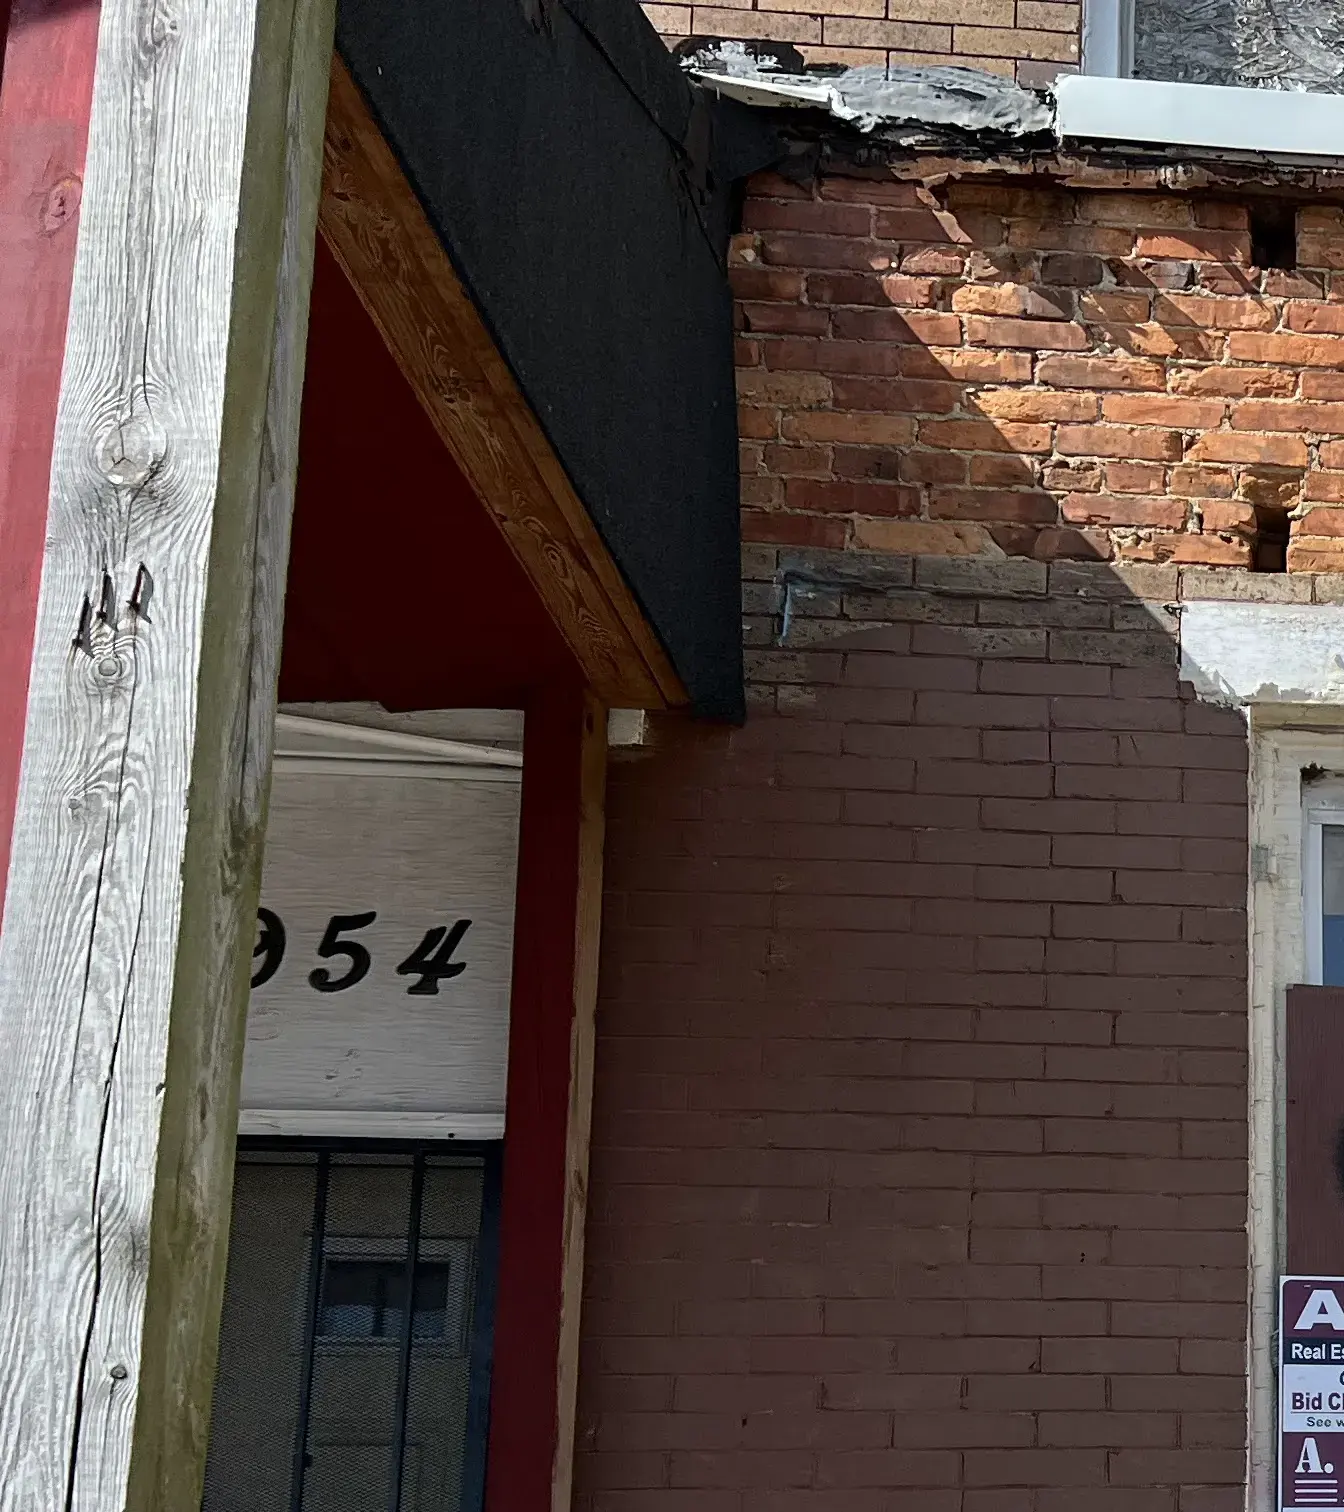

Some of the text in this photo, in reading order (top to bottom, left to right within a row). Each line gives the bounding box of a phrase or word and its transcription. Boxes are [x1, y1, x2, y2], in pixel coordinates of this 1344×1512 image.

[1291, 1344, 1327, 1360] Real
[1292, 1393, 1322, 1410] Bid
[1306, 1417, 1331, 1428] See
[1294, 1438, 1333, 1474] A.
